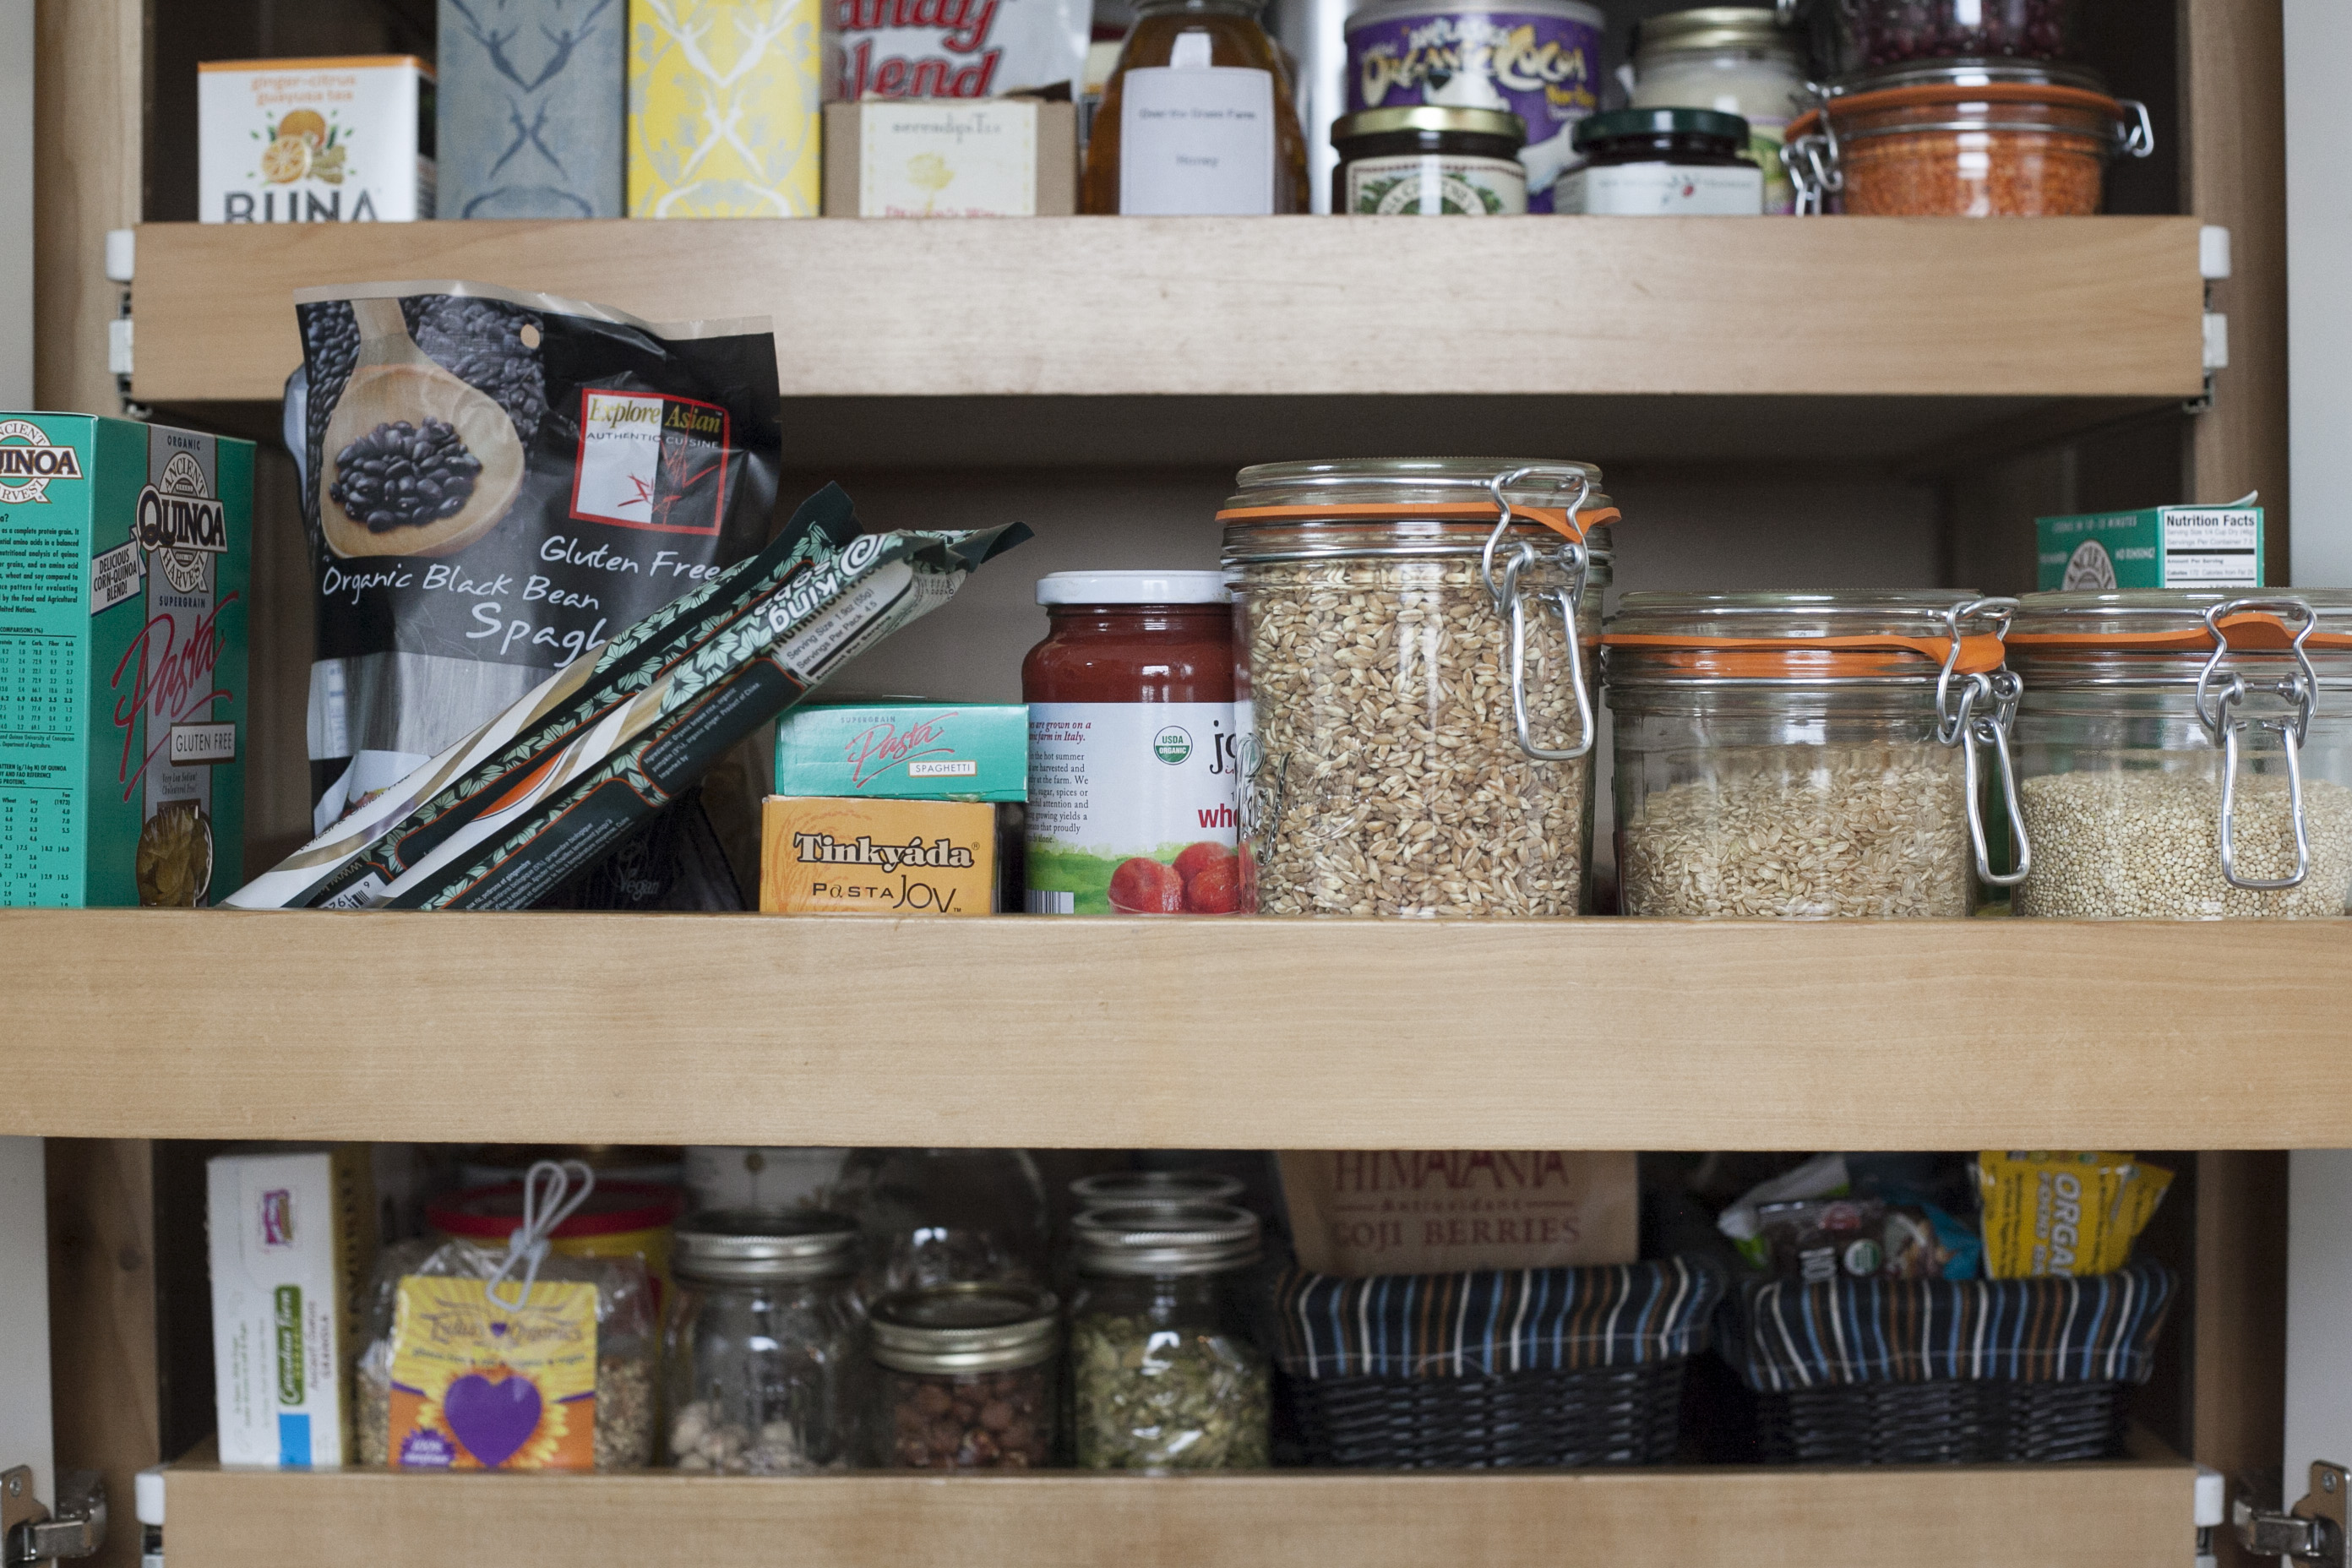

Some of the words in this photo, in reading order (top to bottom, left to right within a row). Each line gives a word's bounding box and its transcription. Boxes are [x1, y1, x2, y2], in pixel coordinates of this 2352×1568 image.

[838, 39, 1002, 100] lend
[589, 398, 661, 429] Explore
[665, 405, 721, 433] Asian
[0, 423, 46, 445] NCIENT
[167, 435, 200, 449] ORGANIC
[587, 432, 662, 443] AUTHENTIC
[666, 436, 719, 449] CUSINE
[166, 458, 206, 494] ANCIENT
[139, 489, 226, 547] QUINOA
[2167, 515, 2219, 526] Nutrition
[2223, 515, 2255, 526] Facts
[14, 527, 36, 536] complete
[29, 550, 51, 558] analysis
[99, 548, 130, 574] DELICIOUS
[540, 535, 639, 574] Gluten
[650, 551, 721, 582] Free
[7, 561, 25, 569] grains,
[162, 550, 204, 588] HARVEST
[46, 573, 71, 581] compared
[94, 560, 137, 591] CORN-QUINOA
[10, 584, 32, 592] pattern
[46, 585, 78, 593] evaluating
[106, 581, 128, 602] BLEND!
[323, 564, 412, 605] Organic
[422, 564, 512, 596] Black
[522, 575, 599, 610] Bean
[47, 596, 77, 604] Agricultural
[159, 595, 205, 608] SUPERGRAIN
[769, 572, 838, 633] king
[787, 633, 819, 660] Serving
[816, 620, 835, 636] Size
[835, 604, 854, 621] 1.9oz
[853, 588, 875, 607] (55g)
[796, 641, 830, 670] Servings
[829, 630, 843, 643] Per
[842, 613, 863, 631] Pack
[864, 601, 878, 613] 4.5
[111, 591, 239, 783] Pasta
[720, 699, 741, 716] Product
[841, 716, 896, 724] SUPERGRAIN
[1045, 722, 1070, 733] grown
[672, 725, 692, 741] Organic
[1037, 731, 1054, 744] farm
[1054, 732, 1062, 741] in
[1063, 731, 1086, 745] Italy.
[1162, 735, 1184, 744] USDA
[176, 733, 210, 753] GLUTEN
[215, 732, 232, 751] FREE
[844, 712, 958, 782] Pasta
[1044, 751, 1054, 760] hot
[915, 763, 971, 773] SPAGHETTI
[1040, 762, 1069, 773] harvested
[1070, 763, 1085, 773] and
[1043, 775, 1053, 784] the
[1054, 775, 1072, 784] farm.
[1075, 775, 1089, 785] We
[1038, 789, 1055, 798] sugar,
[1056, 788, 1077, 799] spices
[1043, 799, 1072, 808] attention
[1074, 799, 1089, 808] and
[1036, 811, 1058, 822] growing
[1059, 811, 1081, 822] yields
[1040, 822, 1052, 831] that
[1054, 823, 1081, 835] proudly
[545, 841, 570, 862] gingembre
[568, 823, 593, 844] biologique
[793, 832, 974, 873] Tinkyáda
[506, 860, 531, 882] gingembre
[1424, 1216, 1582, 1247] BERRIES
